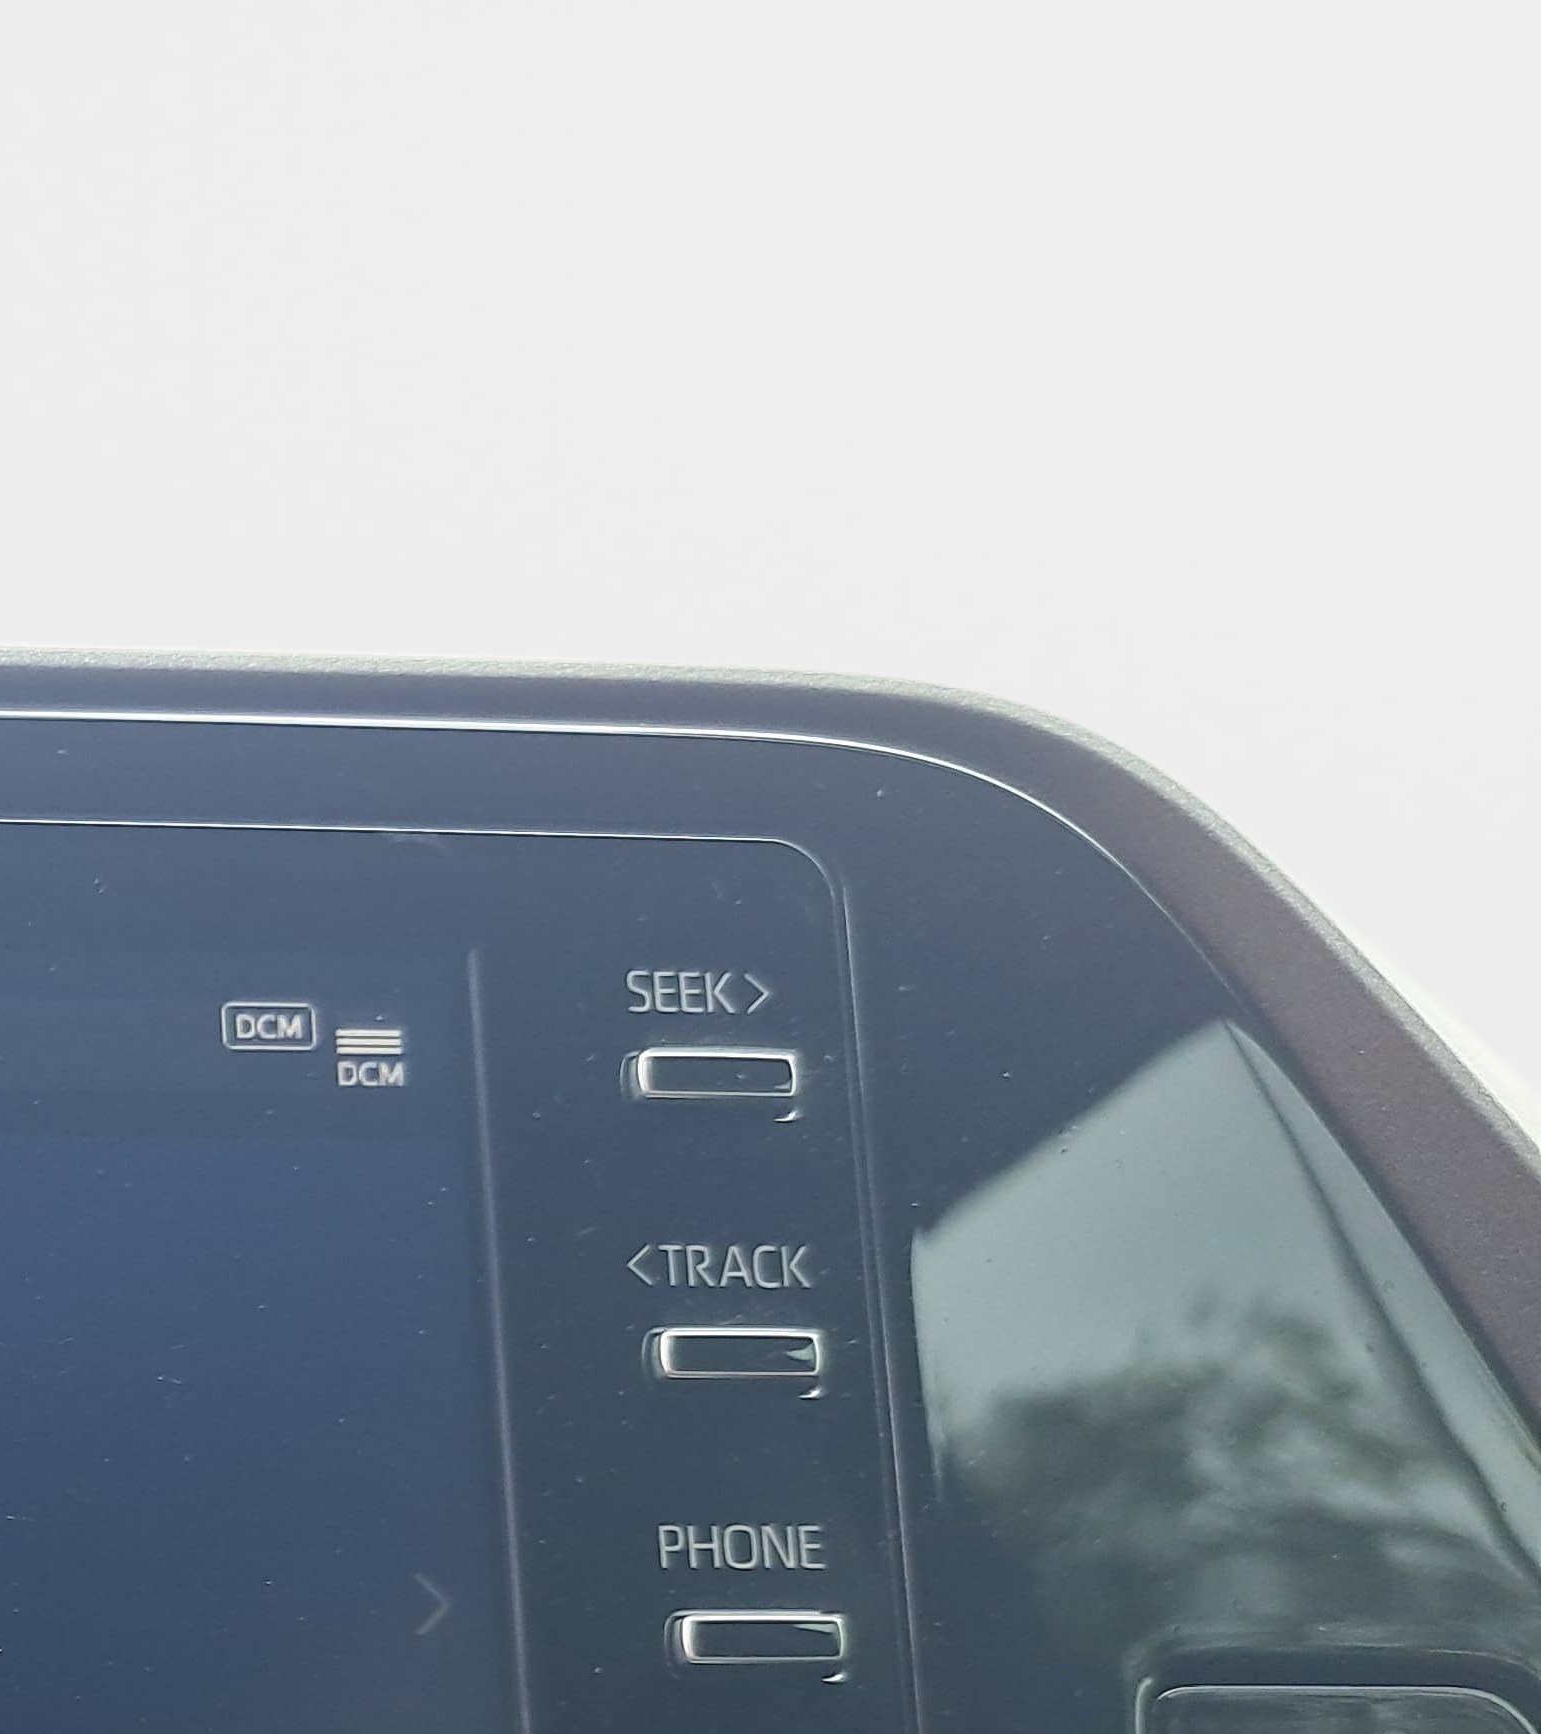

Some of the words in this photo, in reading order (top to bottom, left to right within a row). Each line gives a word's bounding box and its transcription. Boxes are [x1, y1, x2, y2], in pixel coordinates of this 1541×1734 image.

[237, 1015, 301, 1038] DCM
[339, 1062, 403, 1085] DCM
[660, 1525, 825, 1568] PHONE
